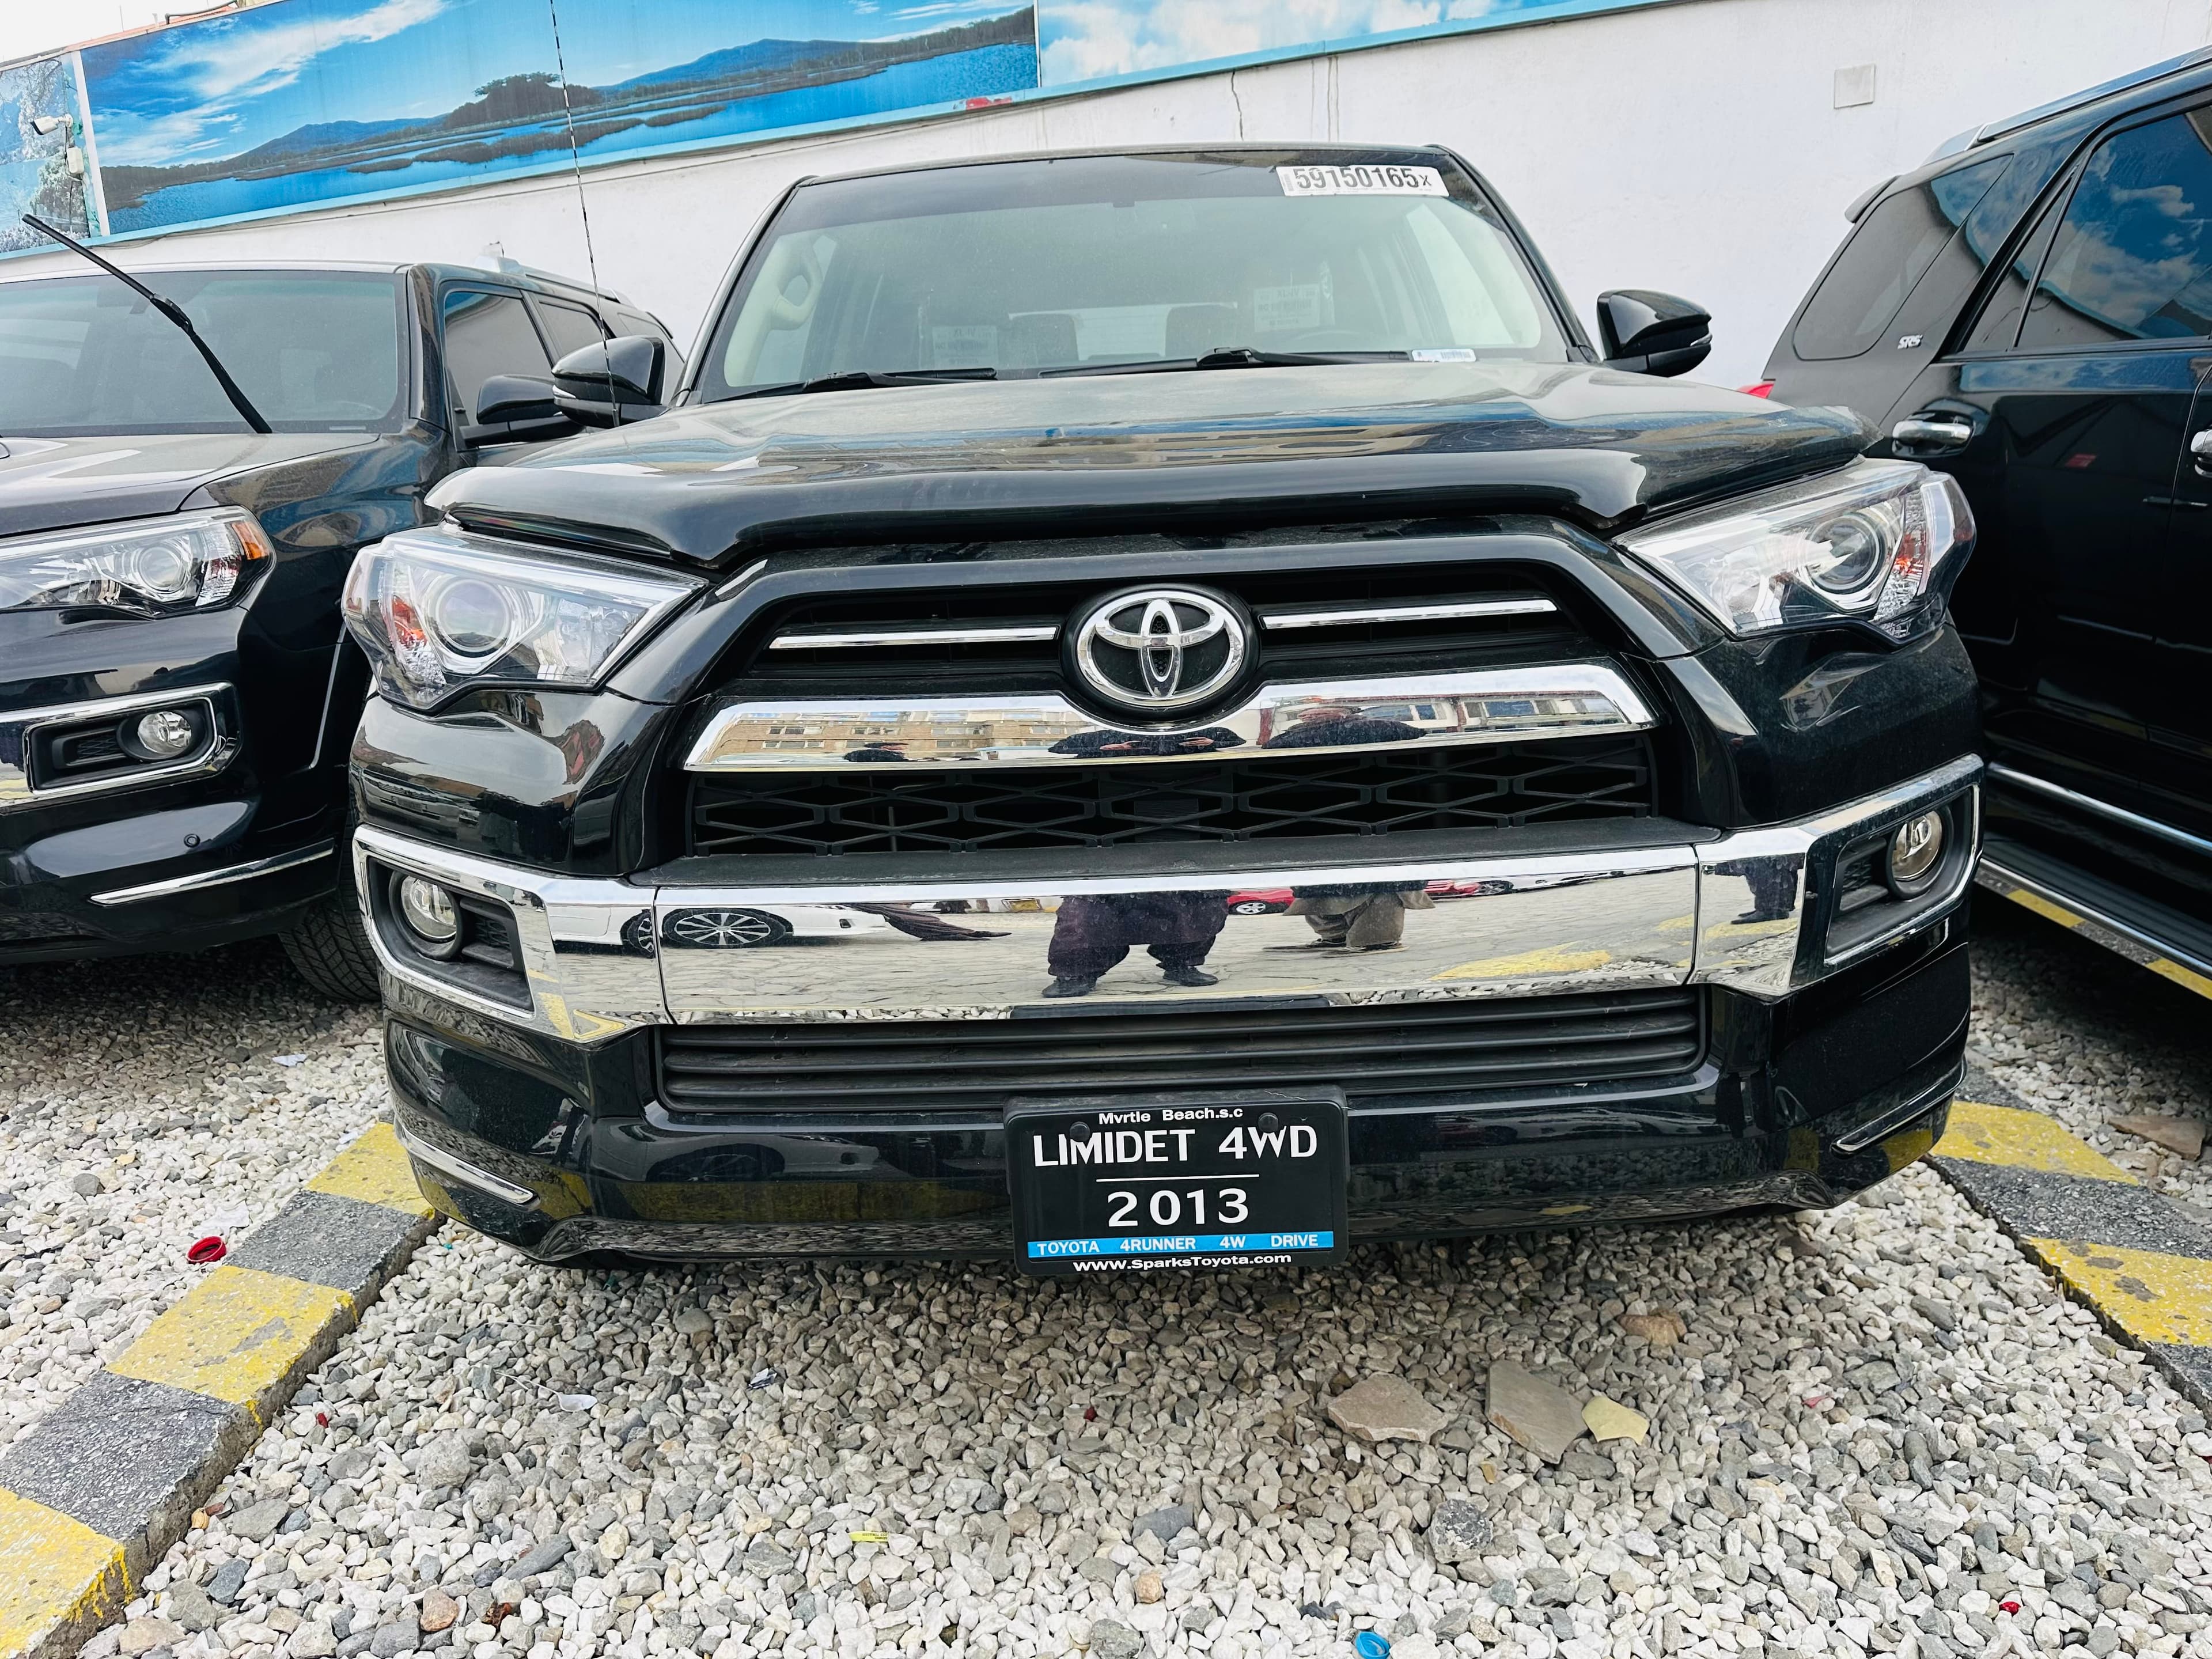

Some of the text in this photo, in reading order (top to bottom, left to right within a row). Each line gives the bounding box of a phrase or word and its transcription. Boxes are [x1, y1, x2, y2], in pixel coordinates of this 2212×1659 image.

[1162, 1107, 1244, 1121] Beach.s.c
[1034, 1125, 1317, 1167] LIMIDET 4WD
[1108, 1188, 1248, 1227] 2013
[1037, 1234, 1318, 1255] TOYOTA 4RUNNER 4W DRIVE
[1073, 1253, 1291, 1271] www.SparksToyota.com
